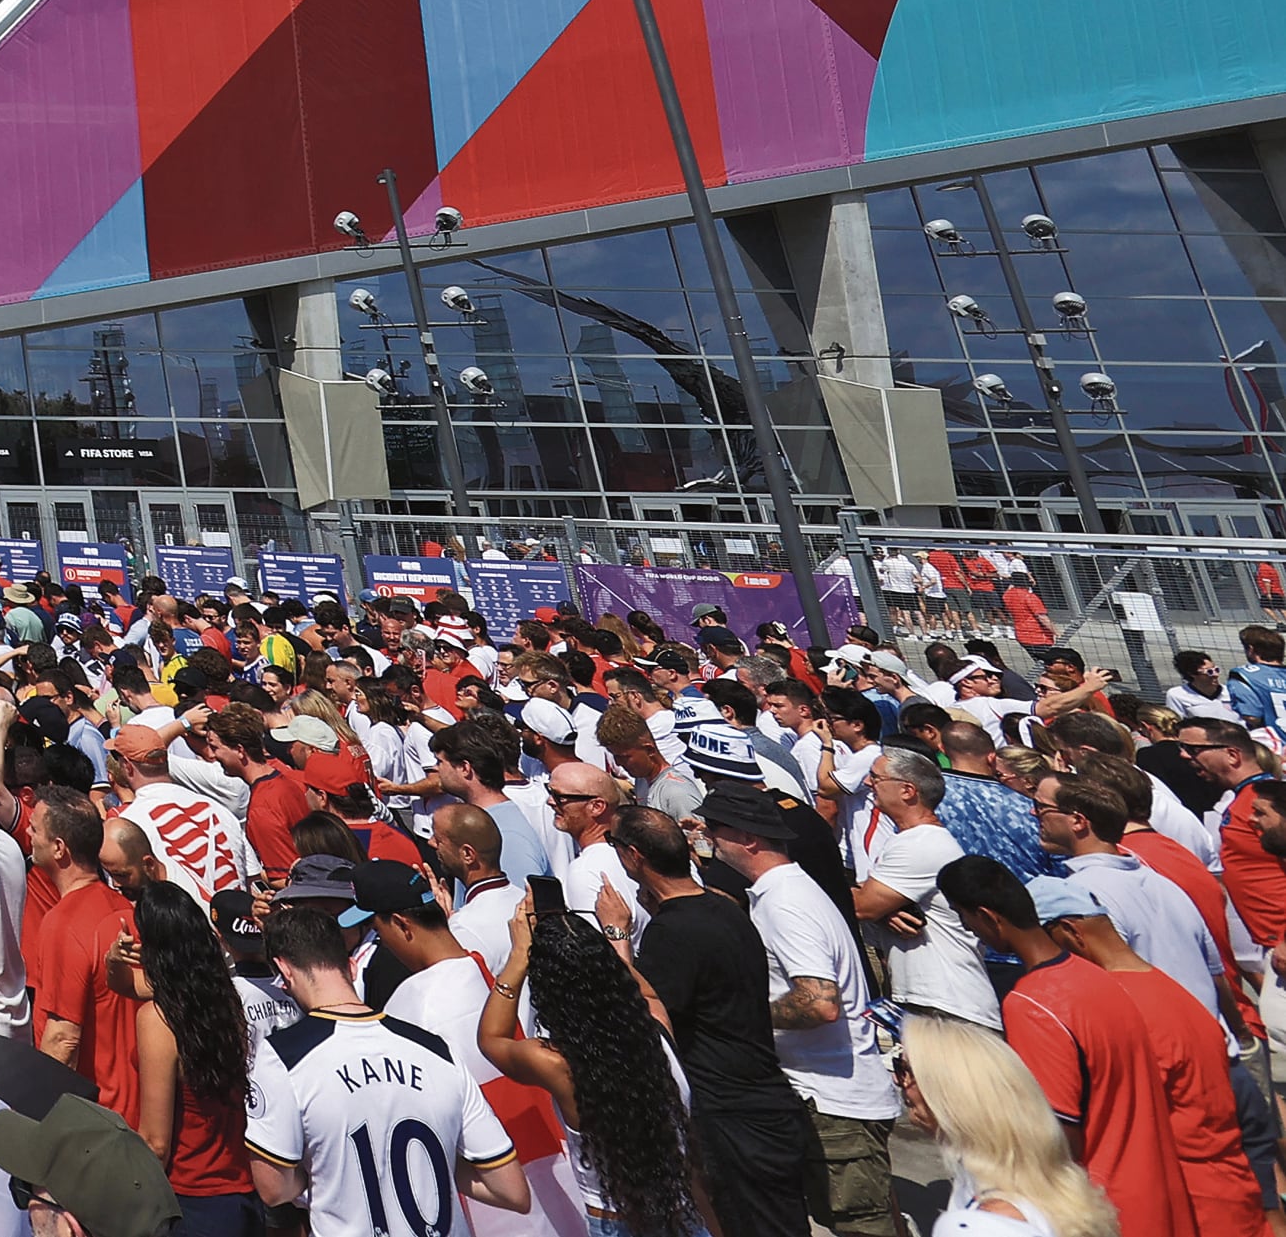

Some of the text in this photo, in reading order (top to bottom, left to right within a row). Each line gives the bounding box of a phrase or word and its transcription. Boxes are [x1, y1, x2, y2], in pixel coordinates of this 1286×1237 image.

[80, 448, 103, 458] FIFA
[102, 449, 134, 458] STORE
[335, 1057, 423, 1094] KANE
[347, 1117, 453, 1237] 10
